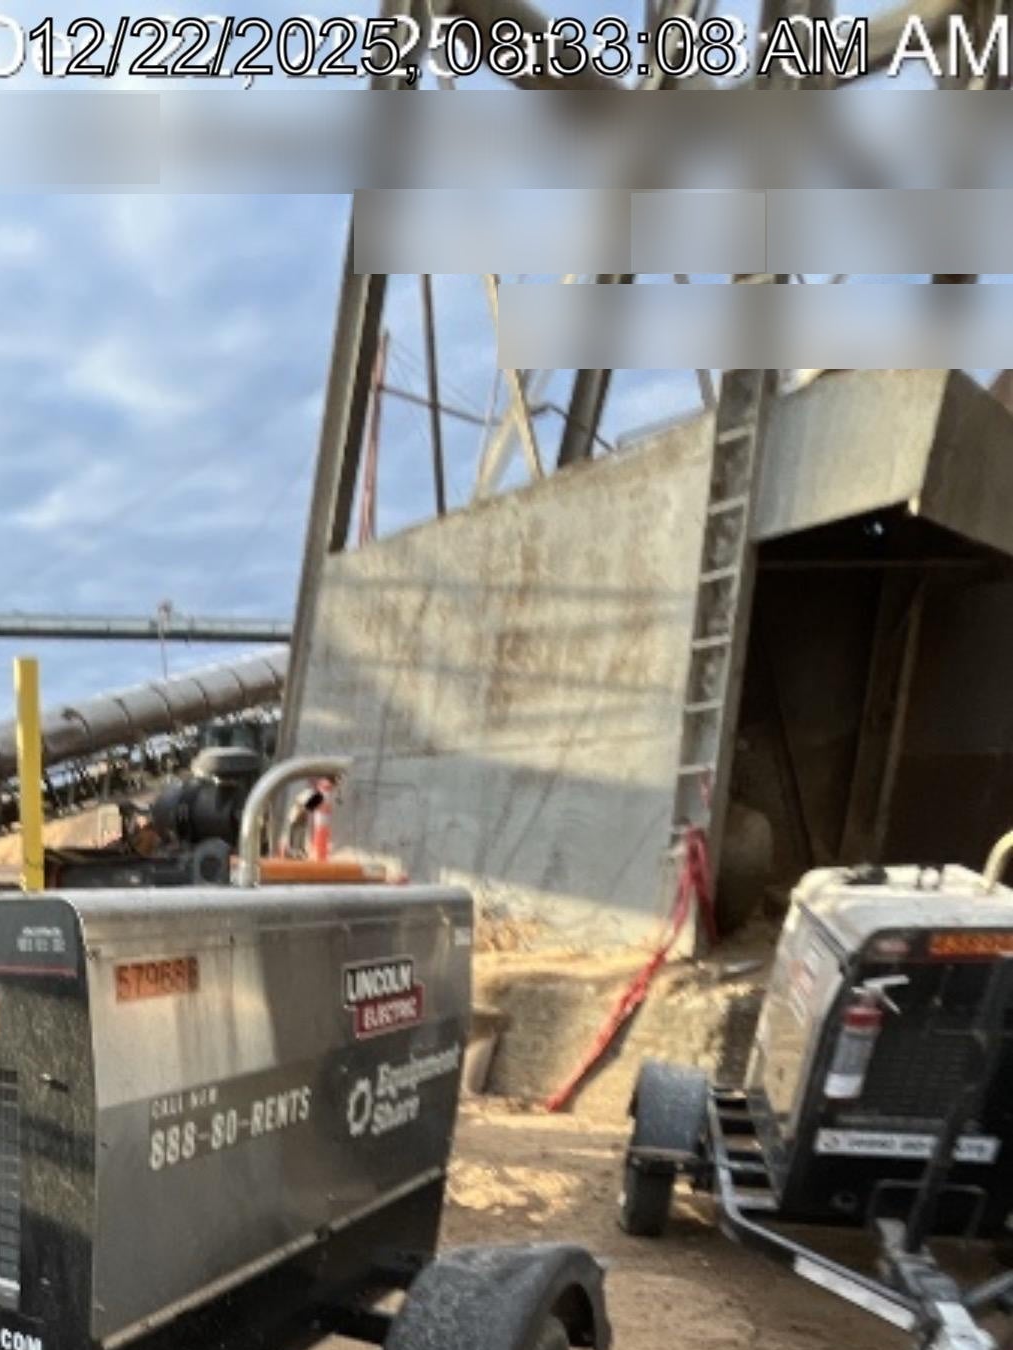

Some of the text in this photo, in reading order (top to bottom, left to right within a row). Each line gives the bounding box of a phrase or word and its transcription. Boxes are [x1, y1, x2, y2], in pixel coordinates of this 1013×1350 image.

[346, 965, 412, 1003] LINCOLN
[363, 997, 418, 1030] ELECTRIC
[149, 1084, 313, 1172] 888-80-RENTS
